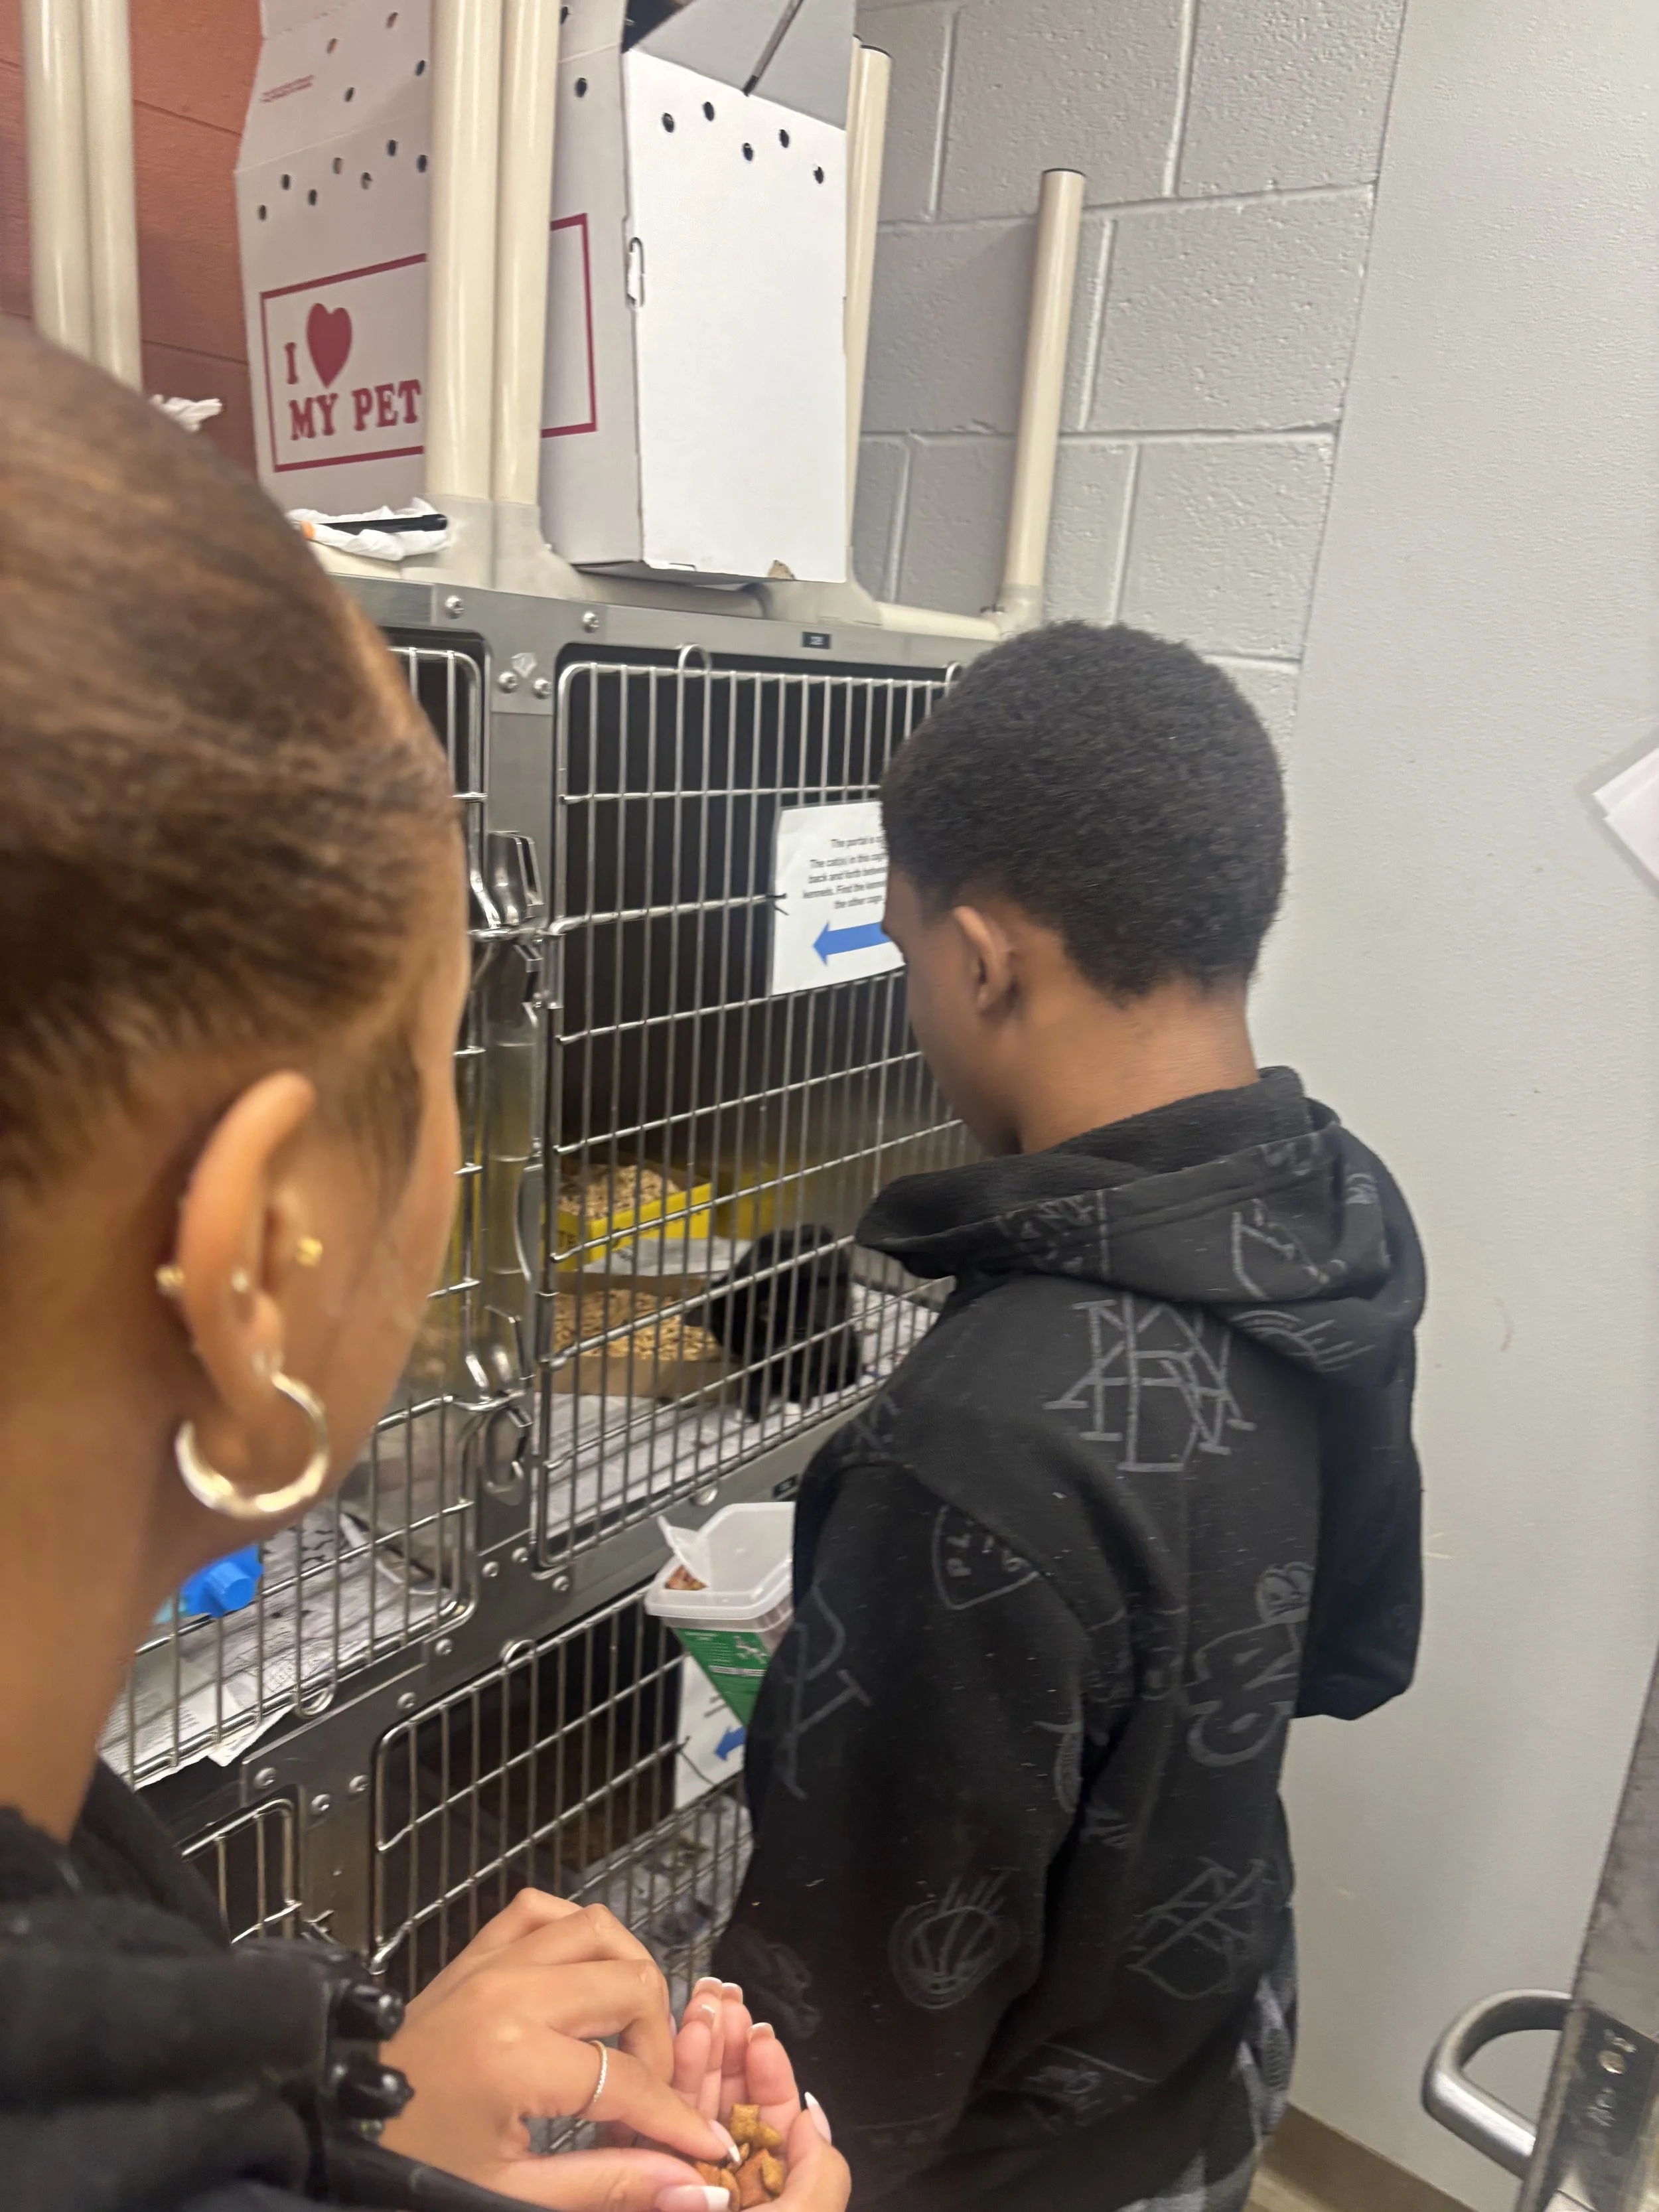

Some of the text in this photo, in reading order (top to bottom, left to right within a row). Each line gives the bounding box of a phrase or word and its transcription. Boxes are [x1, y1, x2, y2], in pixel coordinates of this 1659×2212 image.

[284, 342, 298, 384] I
[288, 379, 422, 441] MY PET
